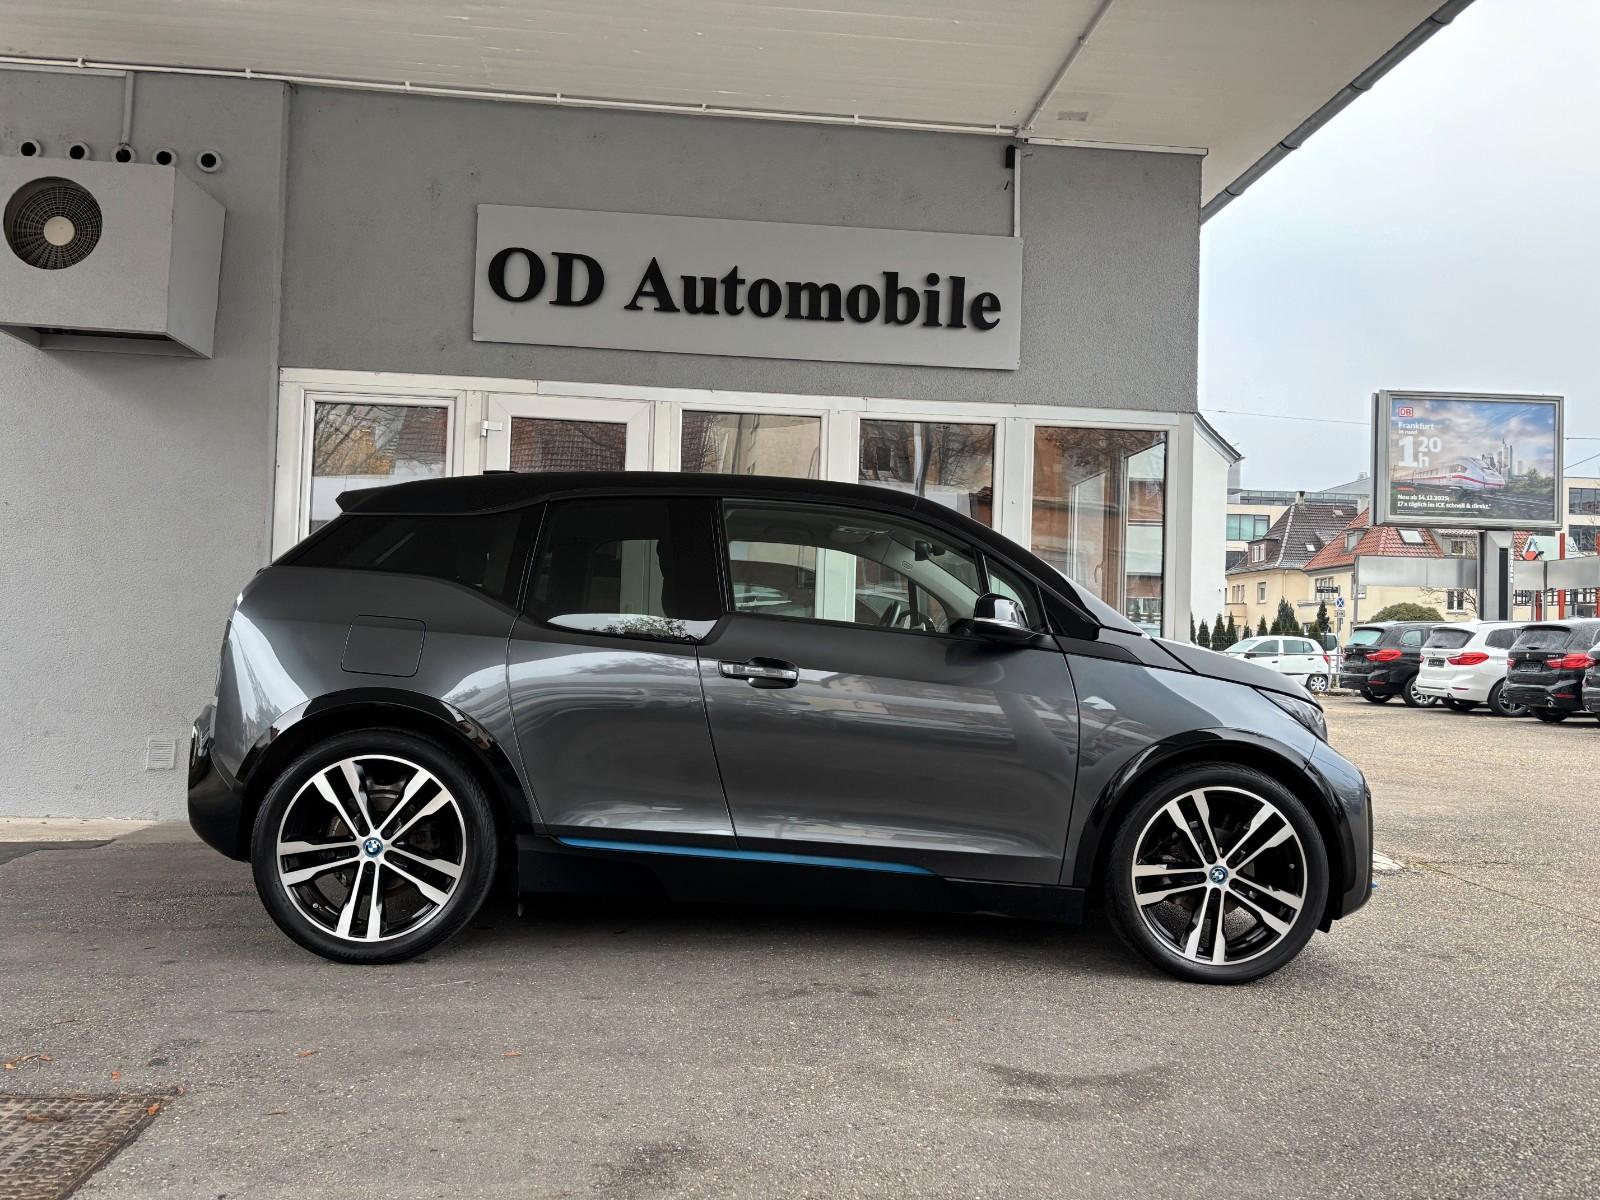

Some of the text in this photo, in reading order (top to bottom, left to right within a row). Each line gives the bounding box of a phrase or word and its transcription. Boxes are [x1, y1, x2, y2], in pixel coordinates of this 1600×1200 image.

[488, 247, 1002, 330] OD Automobile
[1400, 408, 1412, 416] DB
[1398, 422, 1434, 430] Frankfurt
[1398, 435, 1442, 467] 1 20
[1418, 452, 1429, 468] h
